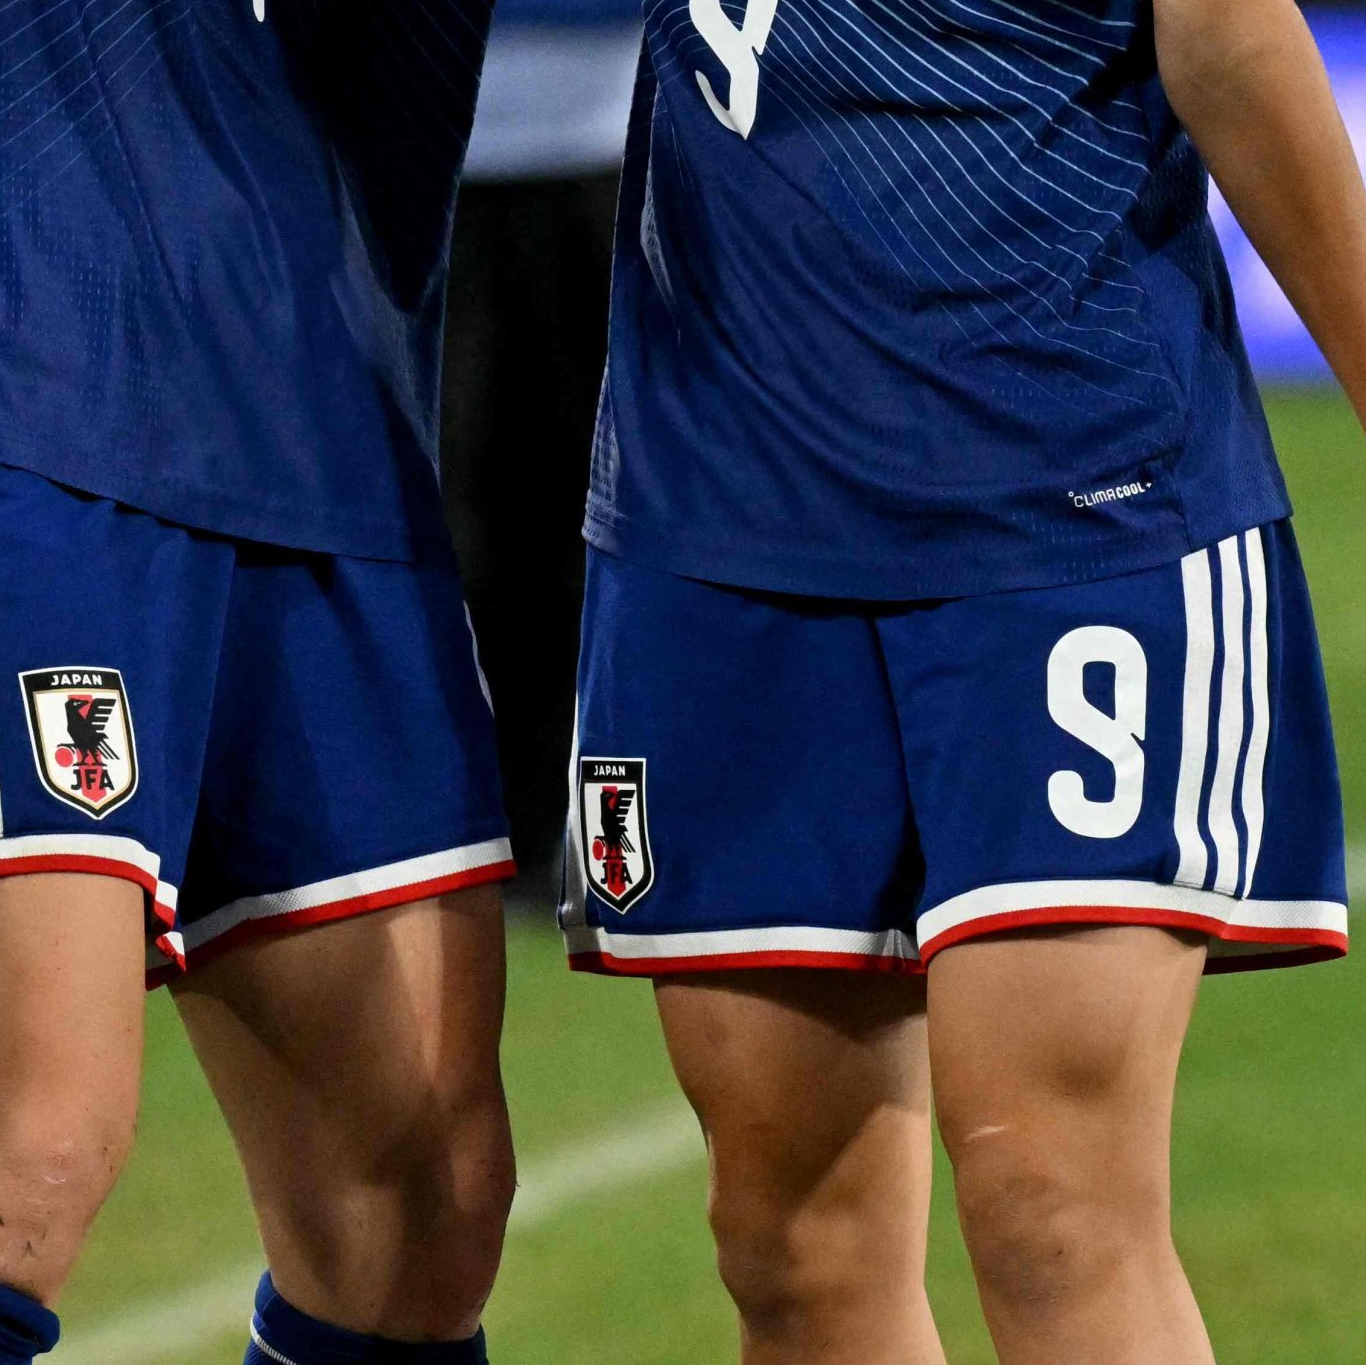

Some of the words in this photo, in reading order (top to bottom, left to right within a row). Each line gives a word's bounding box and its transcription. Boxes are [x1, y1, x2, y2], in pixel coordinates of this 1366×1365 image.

[50, 673, 103, 686] JAPAN
[1046, 624, 1149, 840] 9
[70, 768, 115, 791] JFA
[593, 764, 626, 777] JAPAN
[600, 861, 633, 885] JFA
